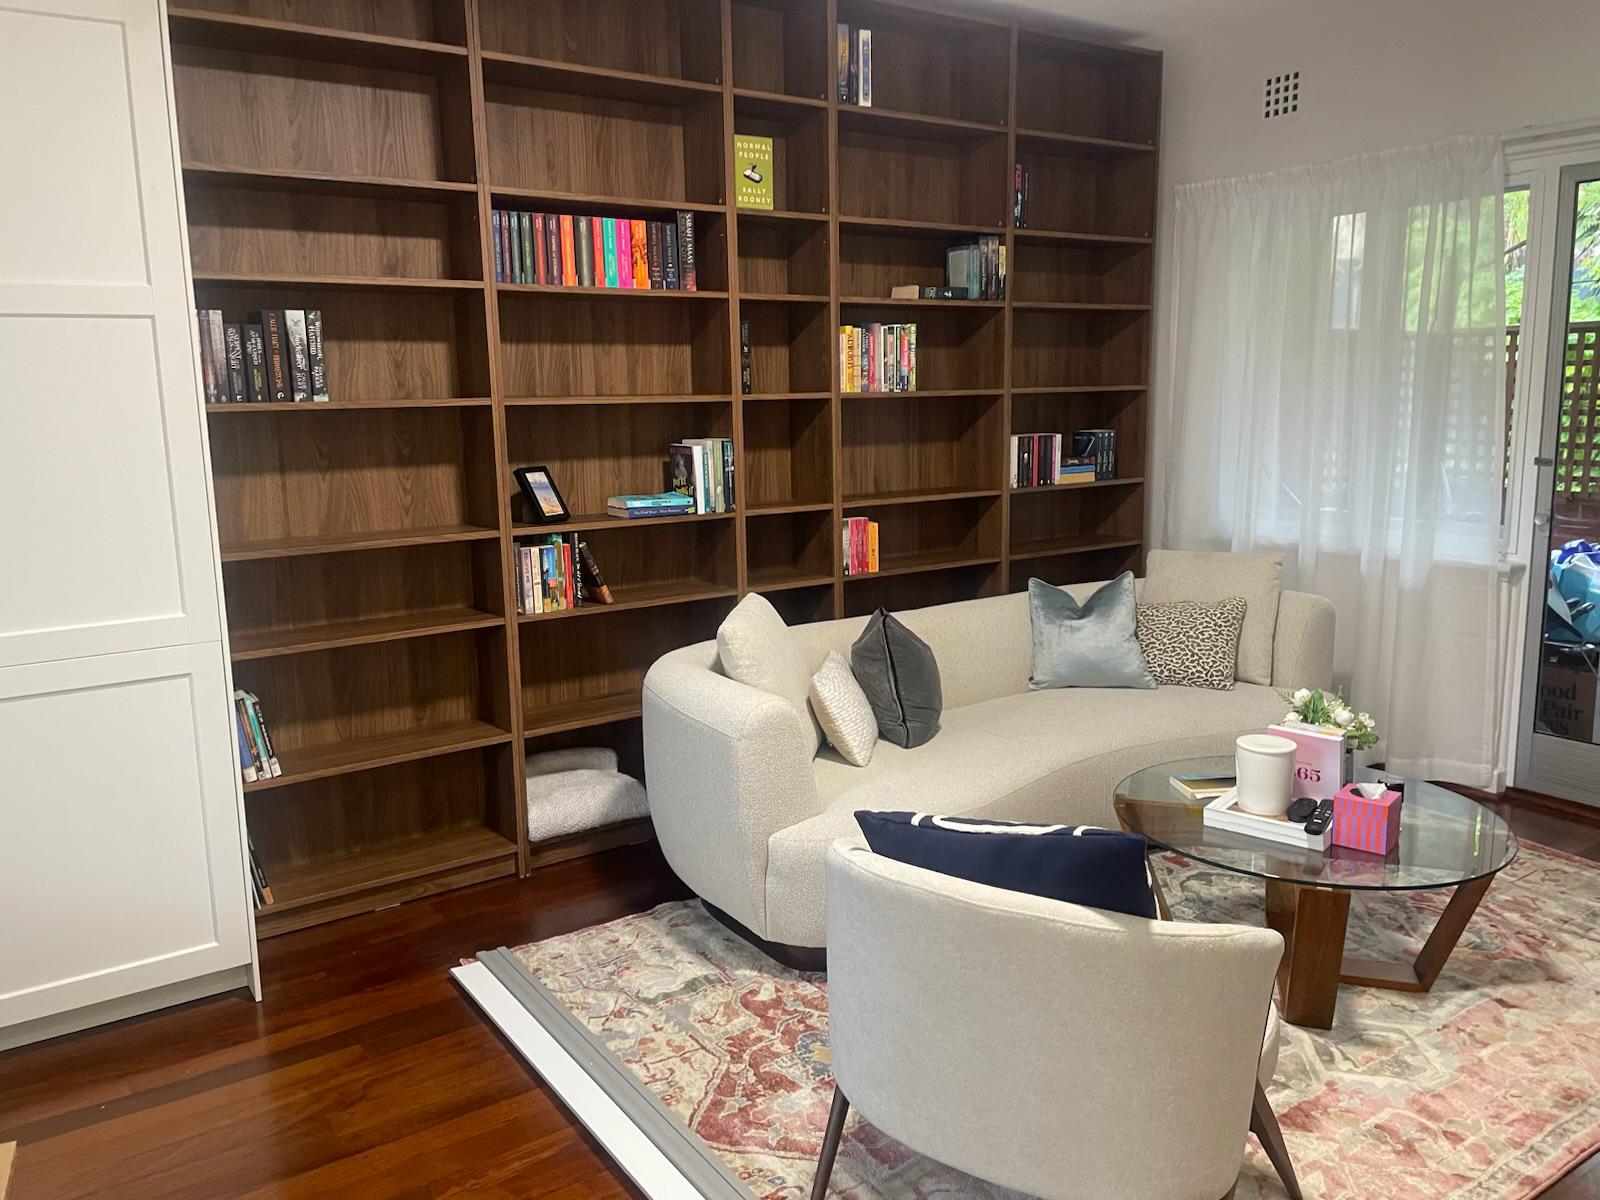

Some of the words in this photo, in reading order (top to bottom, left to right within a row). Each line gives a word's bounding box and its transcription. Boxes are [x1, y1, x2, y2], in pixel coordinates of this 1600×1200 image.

[736, 141, 771, 151] NORMAL
[738, 151, 769, 160] PEOPLE
[742, 186, 766, 194] SALLY
[738, 195, 771, 205] ROONEY
[686, 243, 694, 263] MAAS
[1541, 683, 1577, 701] ood
[1293, 767, 1321, 783] 65
